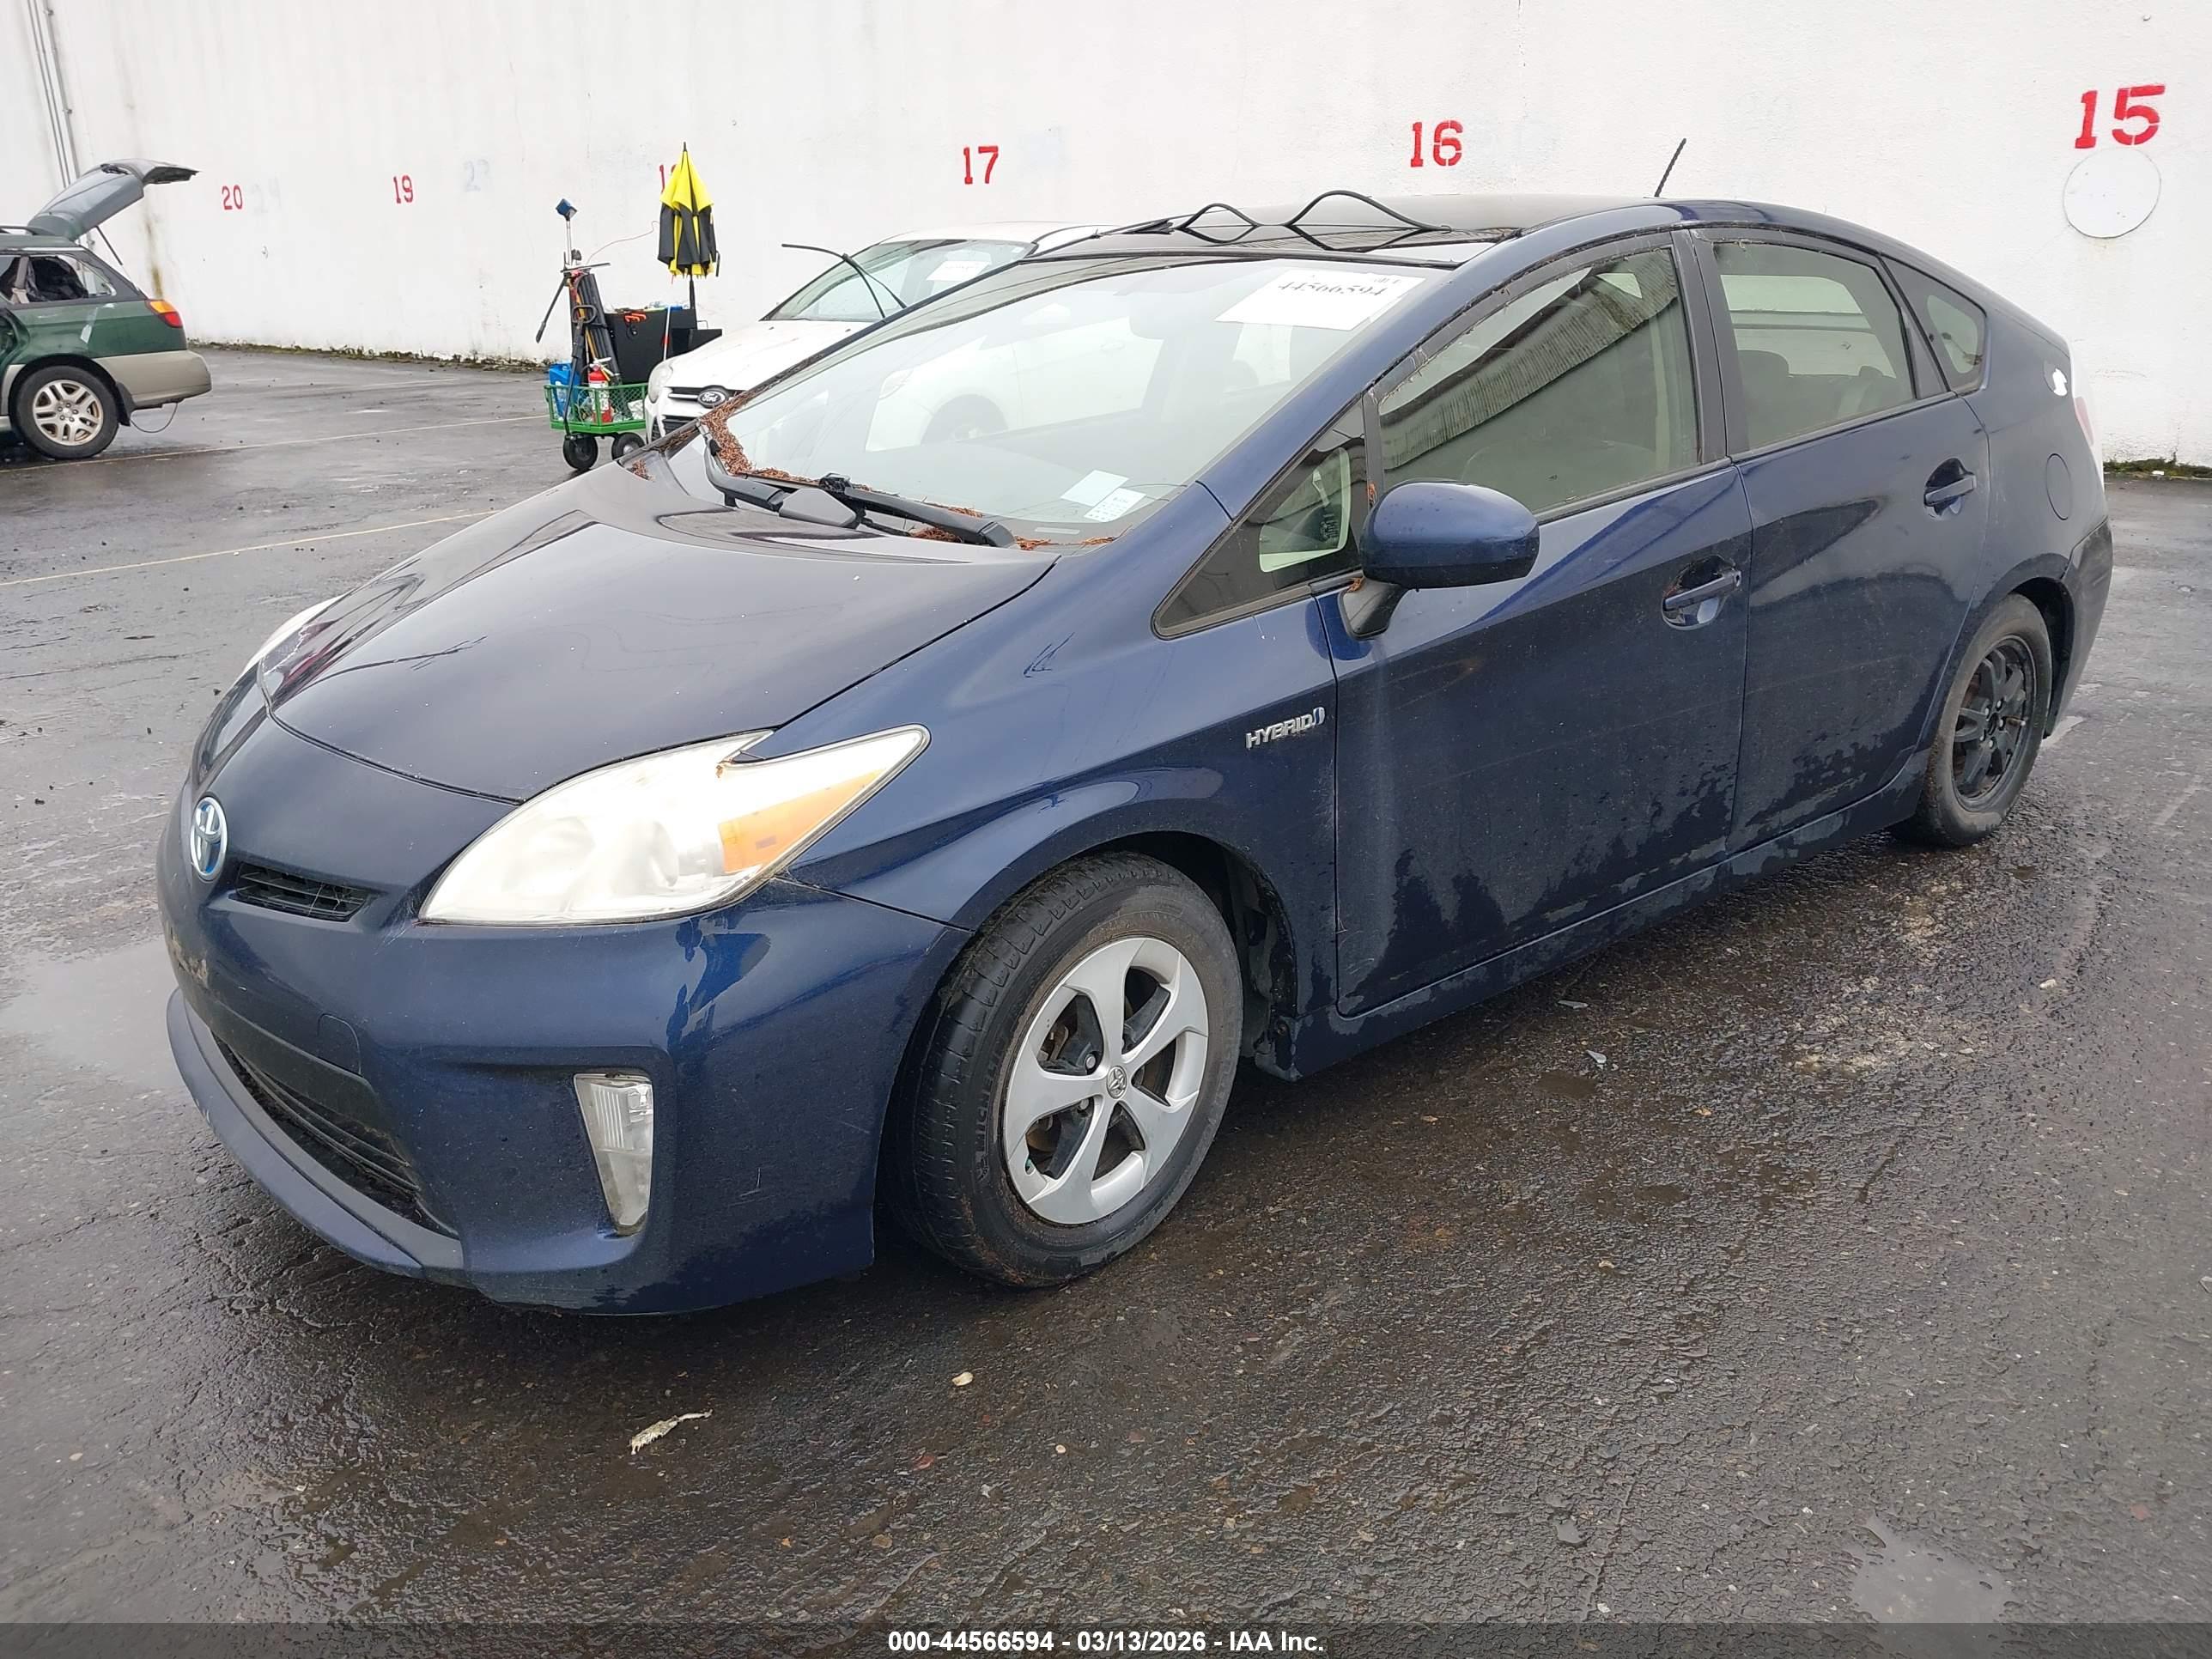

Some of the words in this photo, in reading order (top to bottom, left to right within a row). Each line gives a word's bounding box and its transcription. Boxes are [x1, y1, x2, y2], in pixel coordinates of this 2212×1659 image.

[2075, 84, 2166, 149] 15
[1410, 120, 1463, 167] 16
[659, 164, 677, 194] 1
[963, 145, 999, 185] 17
[222, 184, 243, 210] 20
[392, 174, 414, 204] 19
[1245, 713, 1315, 750] HYBRID
